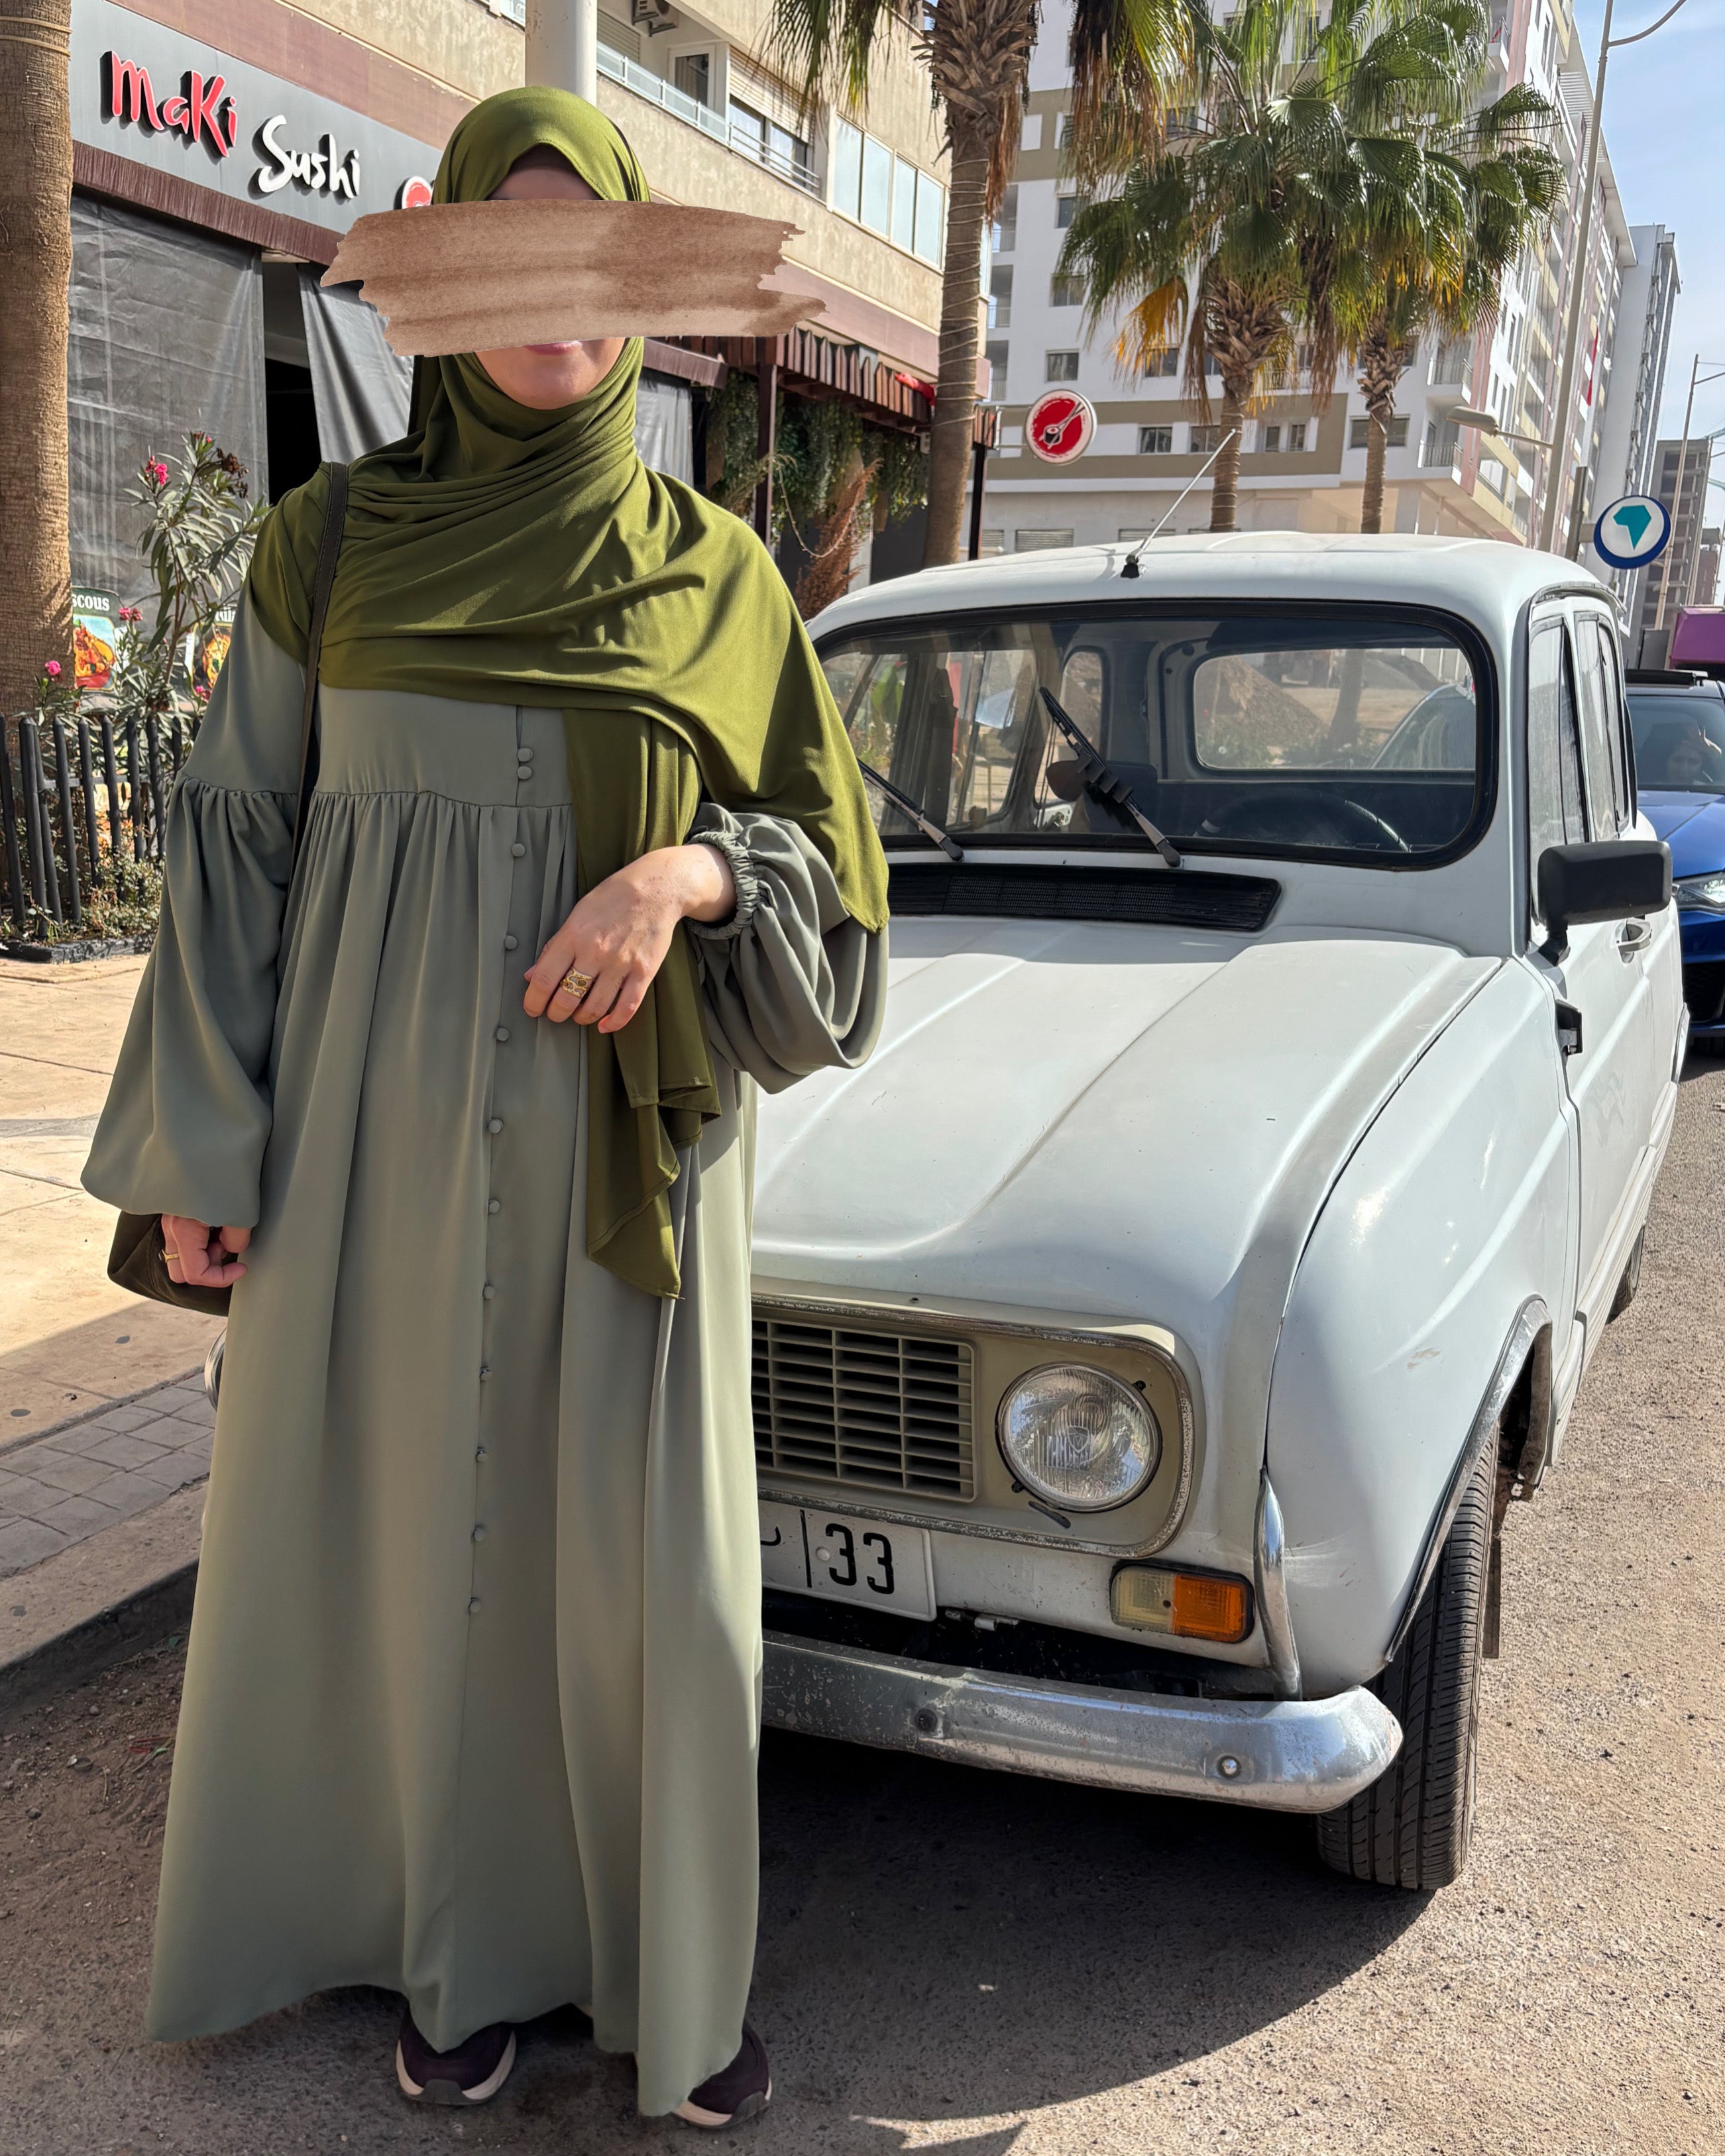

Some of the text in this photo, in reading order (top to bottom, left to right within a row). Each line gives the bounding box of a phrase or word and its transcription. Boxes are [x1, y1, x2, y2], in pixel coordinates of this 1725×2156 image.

[258, 115, 361, 199] Sushi
[71, 593, 110, 612] scous
[825, 1523, 895, 1595] 33
